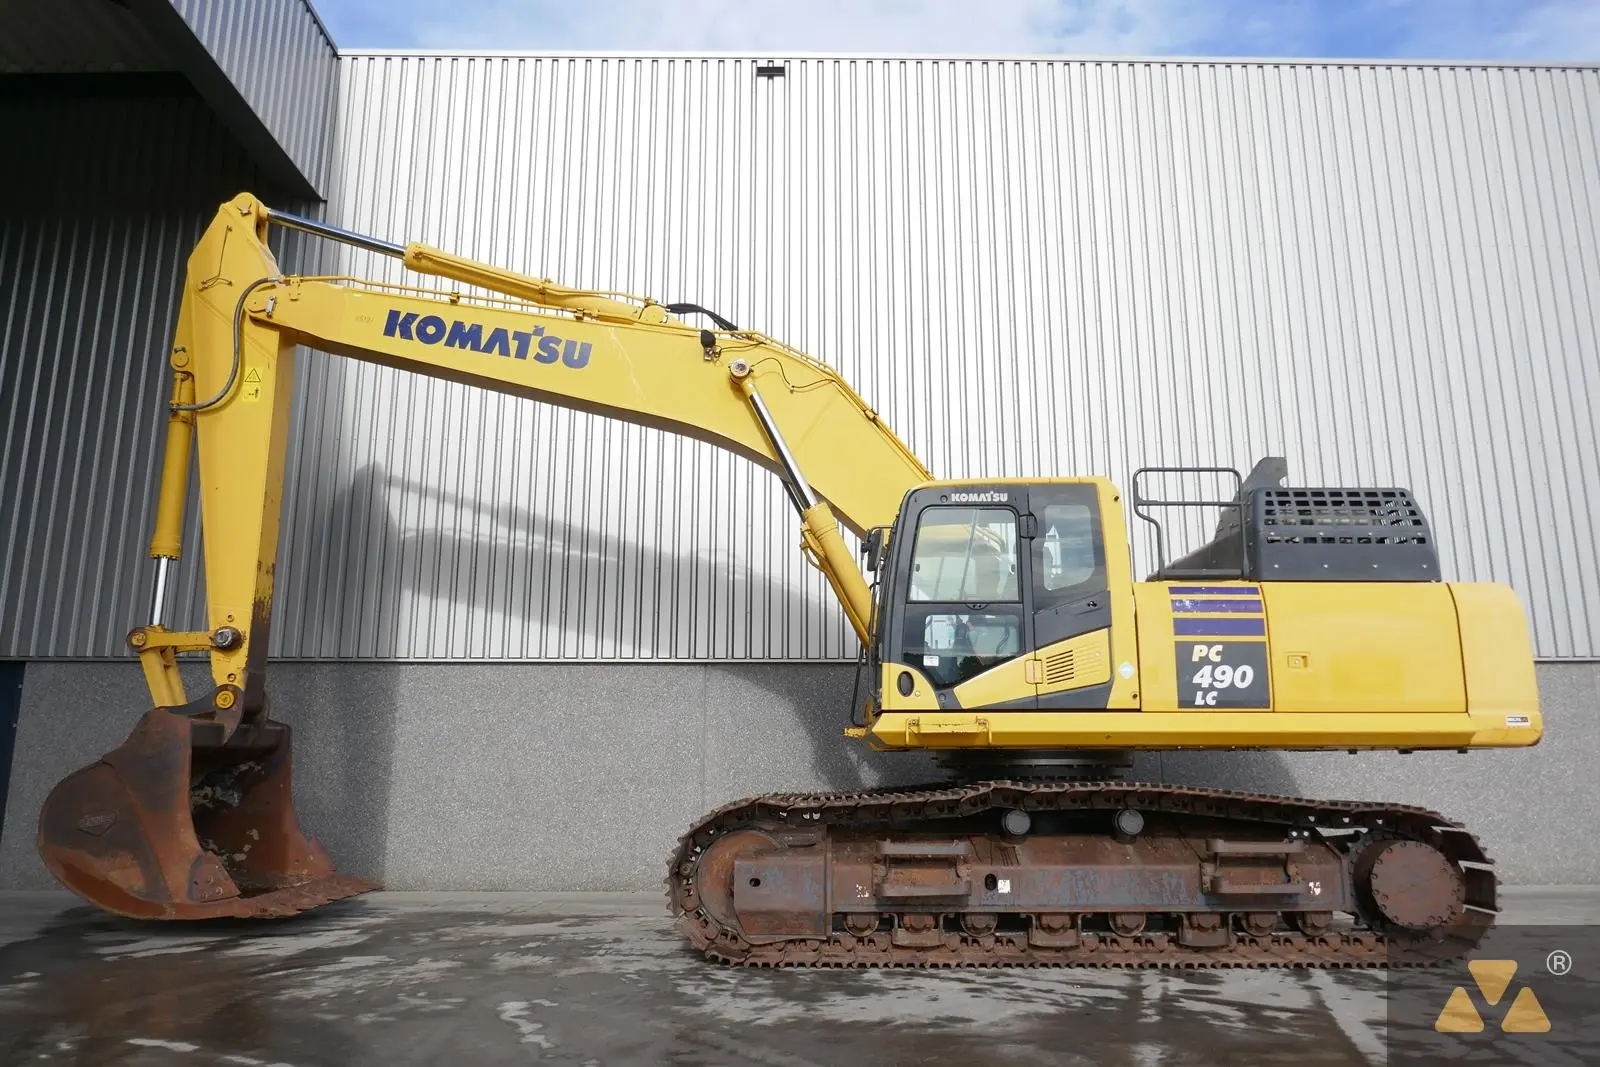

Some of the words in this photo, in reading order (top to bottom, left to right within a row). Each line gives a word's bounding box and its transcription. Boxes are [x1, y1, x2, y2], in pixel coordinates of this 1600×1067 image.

[383, 309, 593, 369] KOMATSU
[951, 490, 1008, 502] KOMATSU
[1191, 644, 1223, 662] PC
[1192, 664, 1254, 689] 490
[1194, 691, 1218, 706] LC
